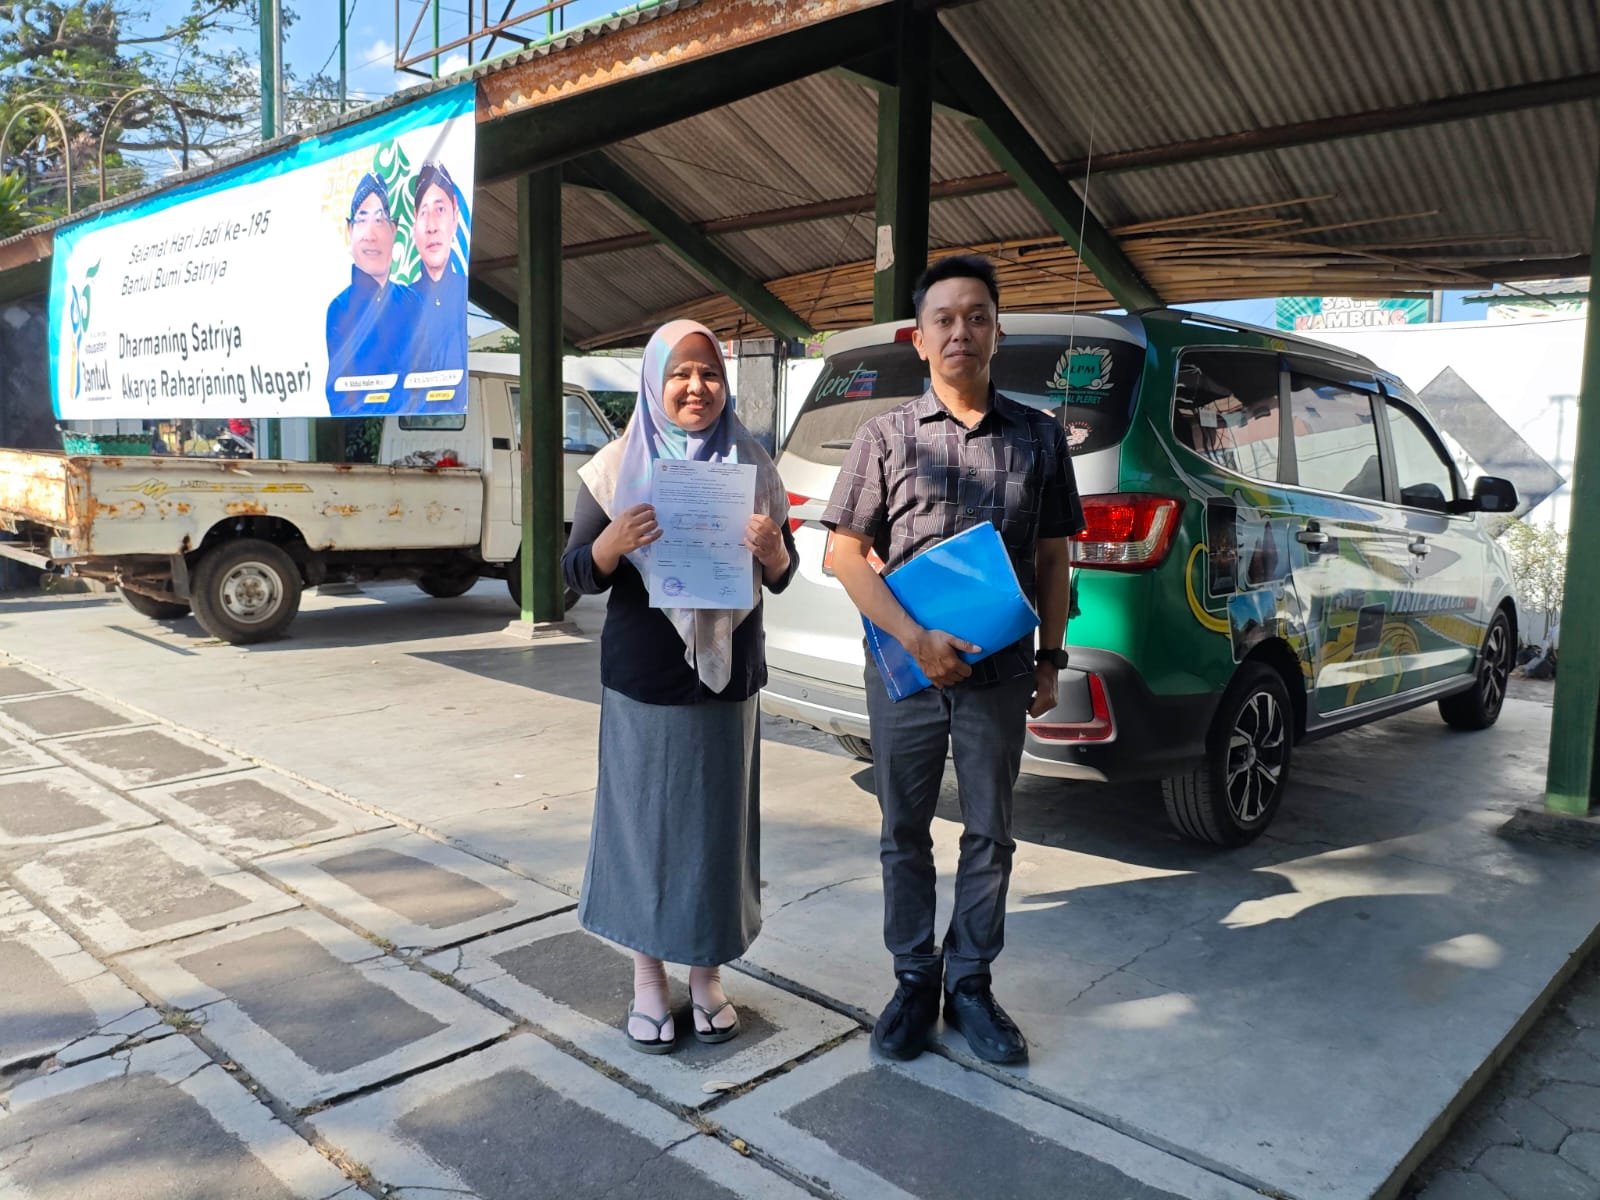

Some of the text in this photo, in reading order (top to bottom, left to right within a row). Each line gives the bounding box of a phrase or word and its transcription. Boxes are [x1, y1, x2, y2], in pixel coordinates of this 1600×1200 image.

[129, 209, 272, 264] Selamat Hari Jadi ke-195
[121, 256, 228, 296] Bantul Bumi Satriya
[119, 320, 242, 361] Dharmaning Satriya
[1295, 309, 1407, 331] KAMBING
[122, 361, 312, 405] Akarya Raharjaning Nagari
